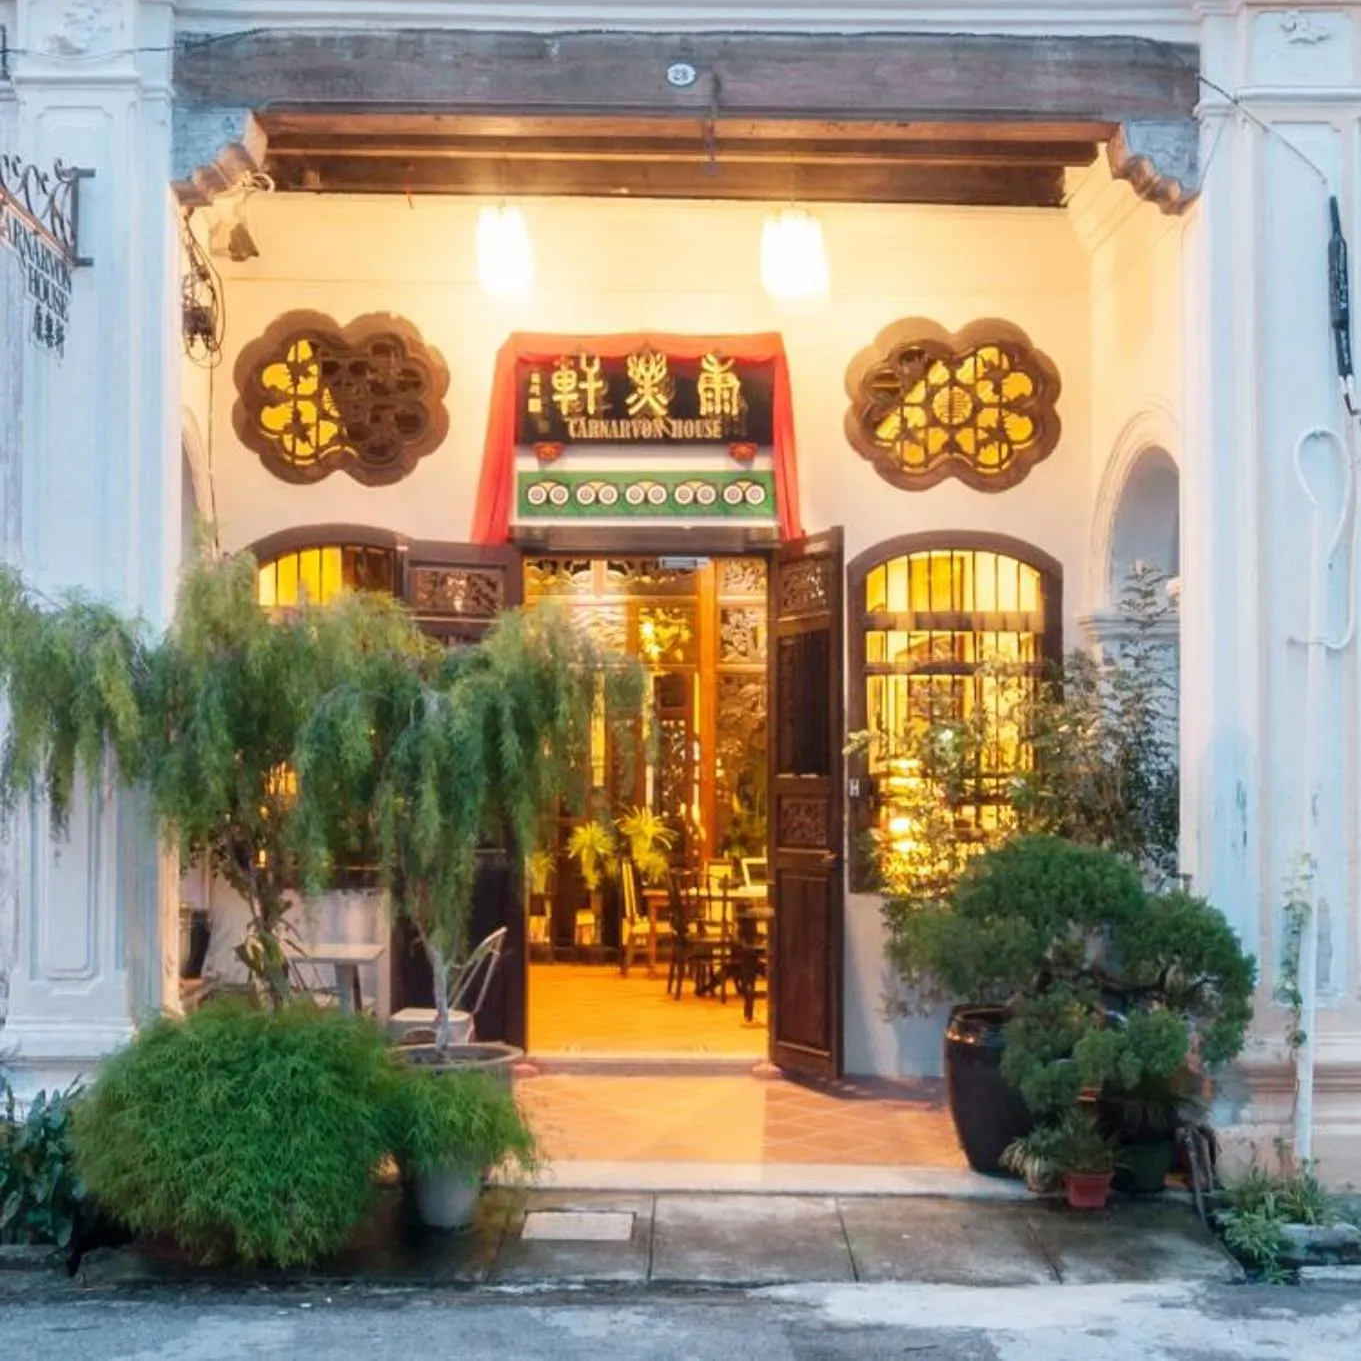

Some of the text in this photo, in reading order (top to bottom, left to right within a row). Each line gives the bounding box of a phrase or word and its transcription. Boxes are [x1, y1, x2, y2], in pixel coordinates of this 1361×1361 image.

[0, 206, 72, 295] ARNARVON
[28, 263, 69, 323] HOUSE
[567, 418, 722, 439] CARNARVON HOUSE
